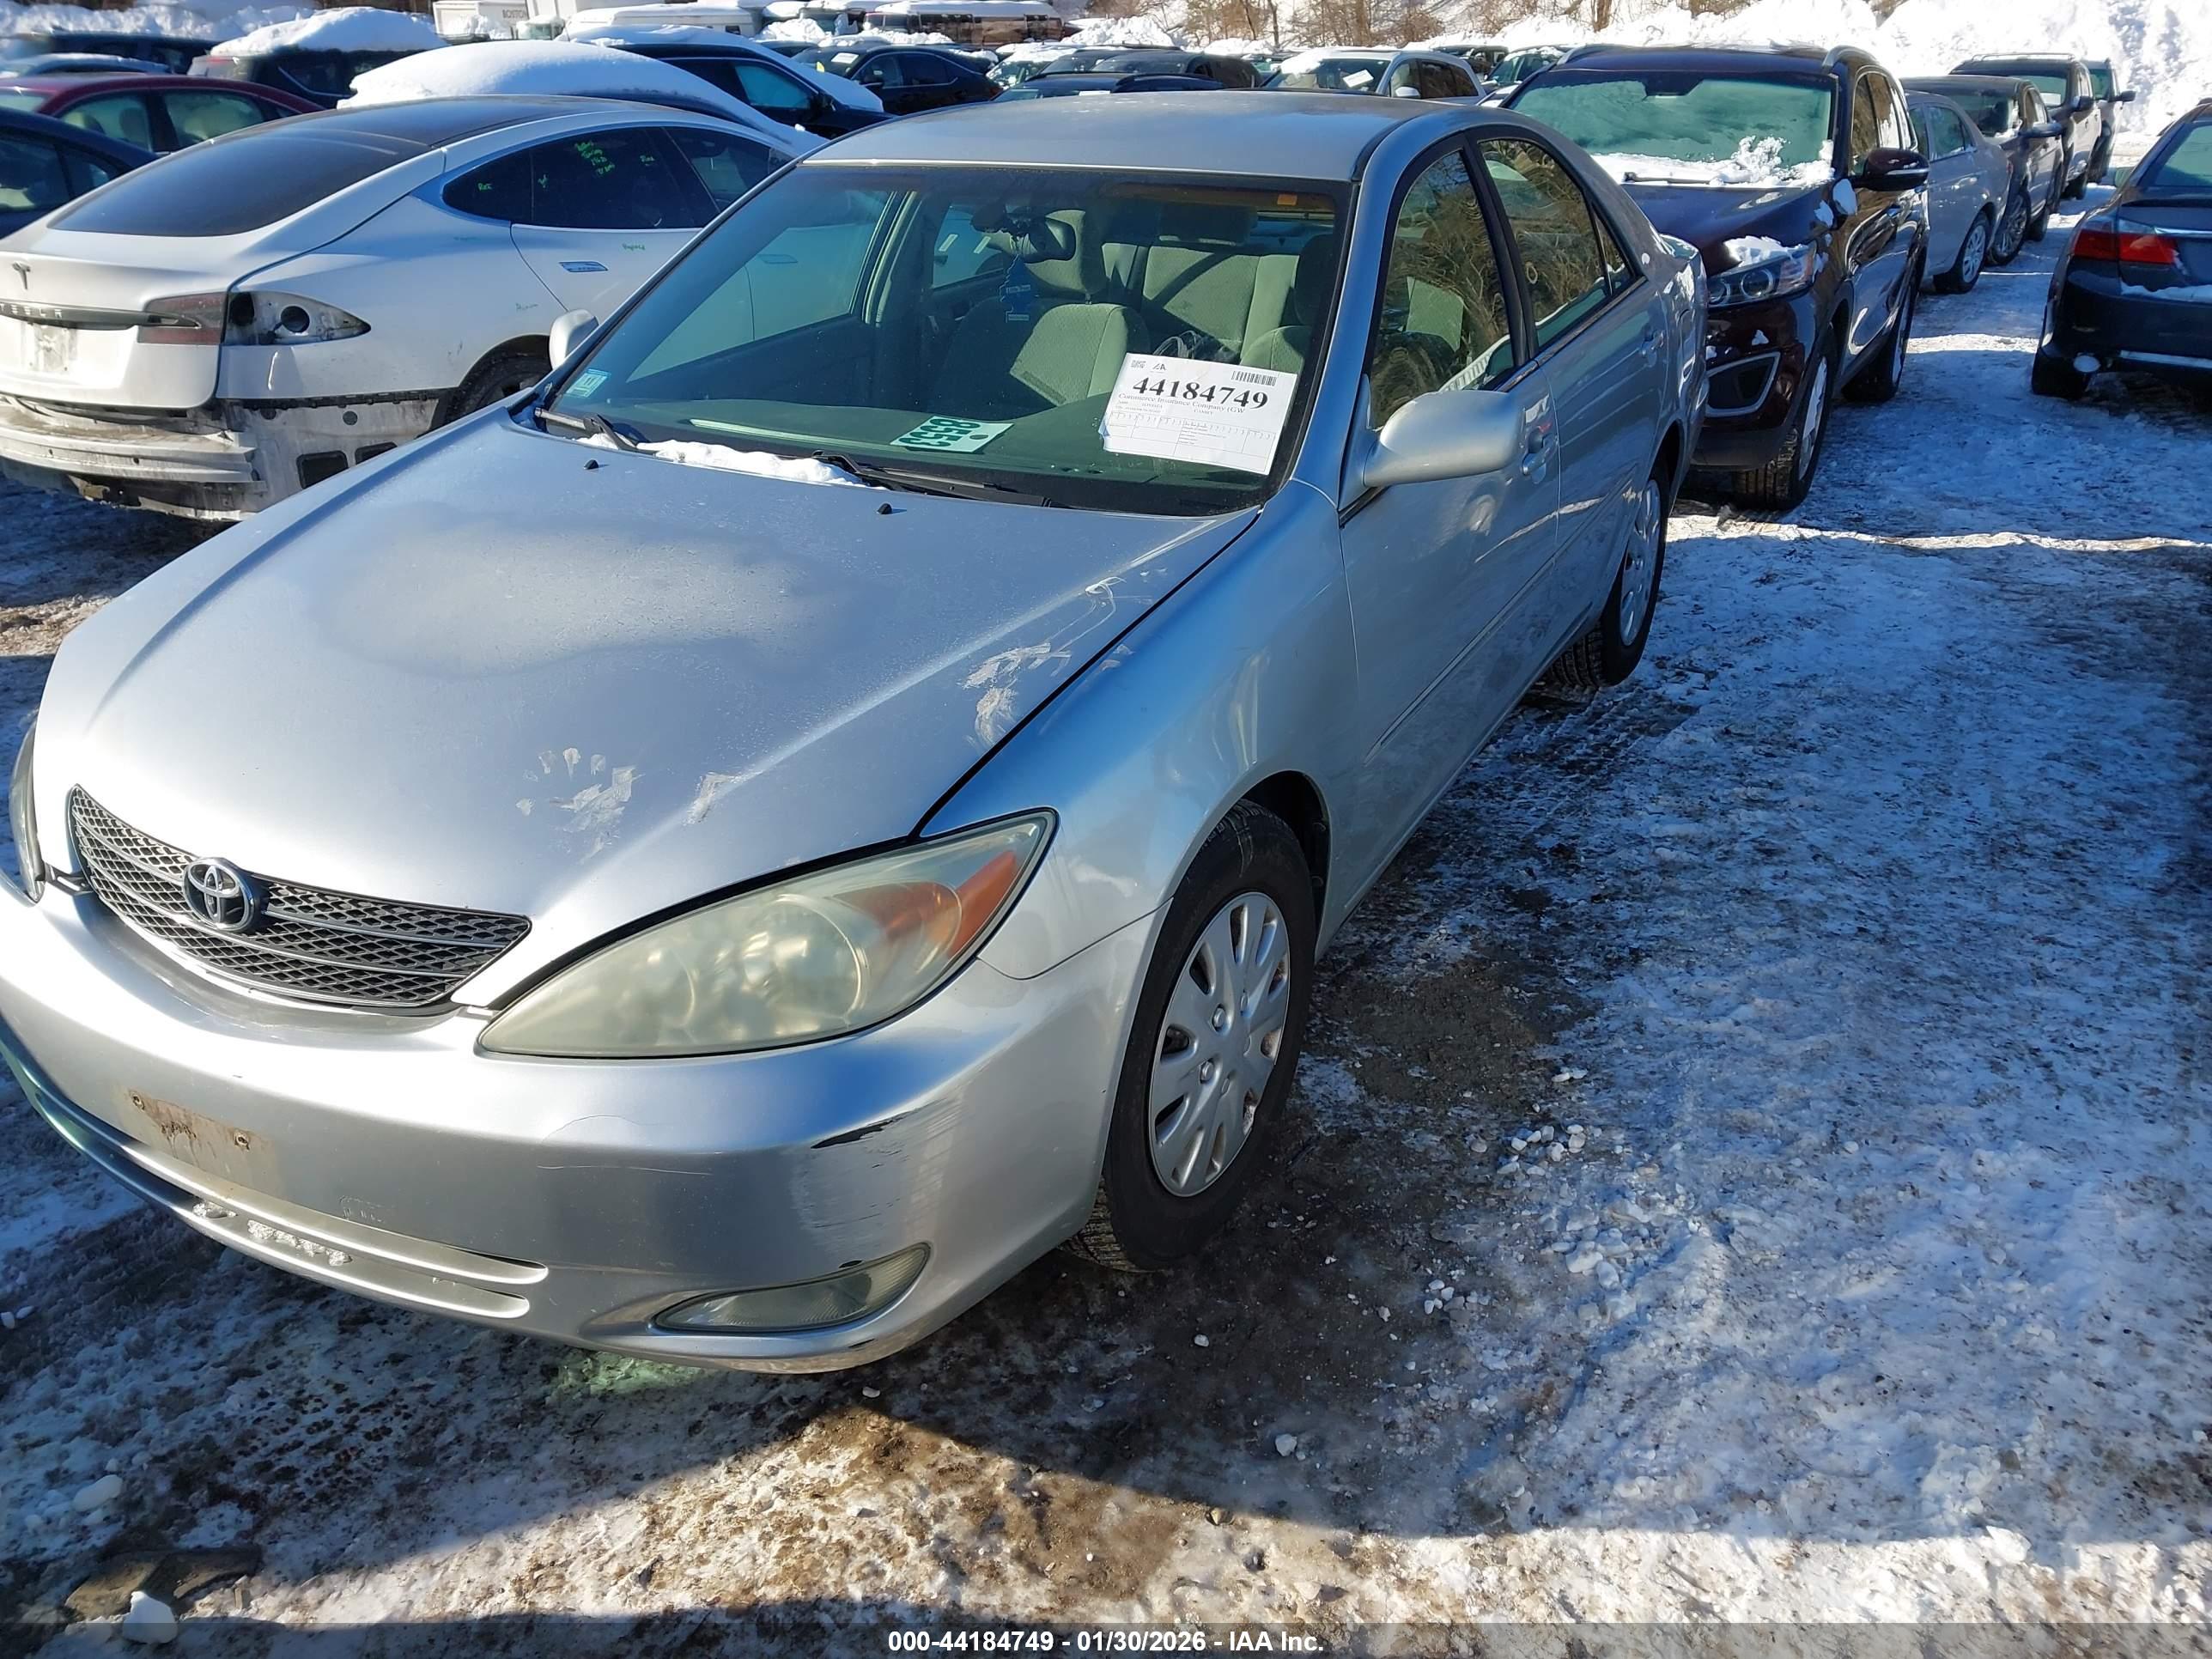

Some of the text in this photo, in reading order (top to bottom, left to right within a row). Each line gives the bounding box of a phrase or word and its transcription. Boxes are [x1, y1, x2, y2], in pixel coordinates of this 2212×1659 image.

[0, 304, 63, 319] TESLA
[1118, 392, 1156, 402] Commerce
[1157, 397, 1190, 407] Insurance
[1192, 401, 1225, 412] Company
[1133, 377, 1268, 411] 44184749
[898, 418, 981, 447] 8553
